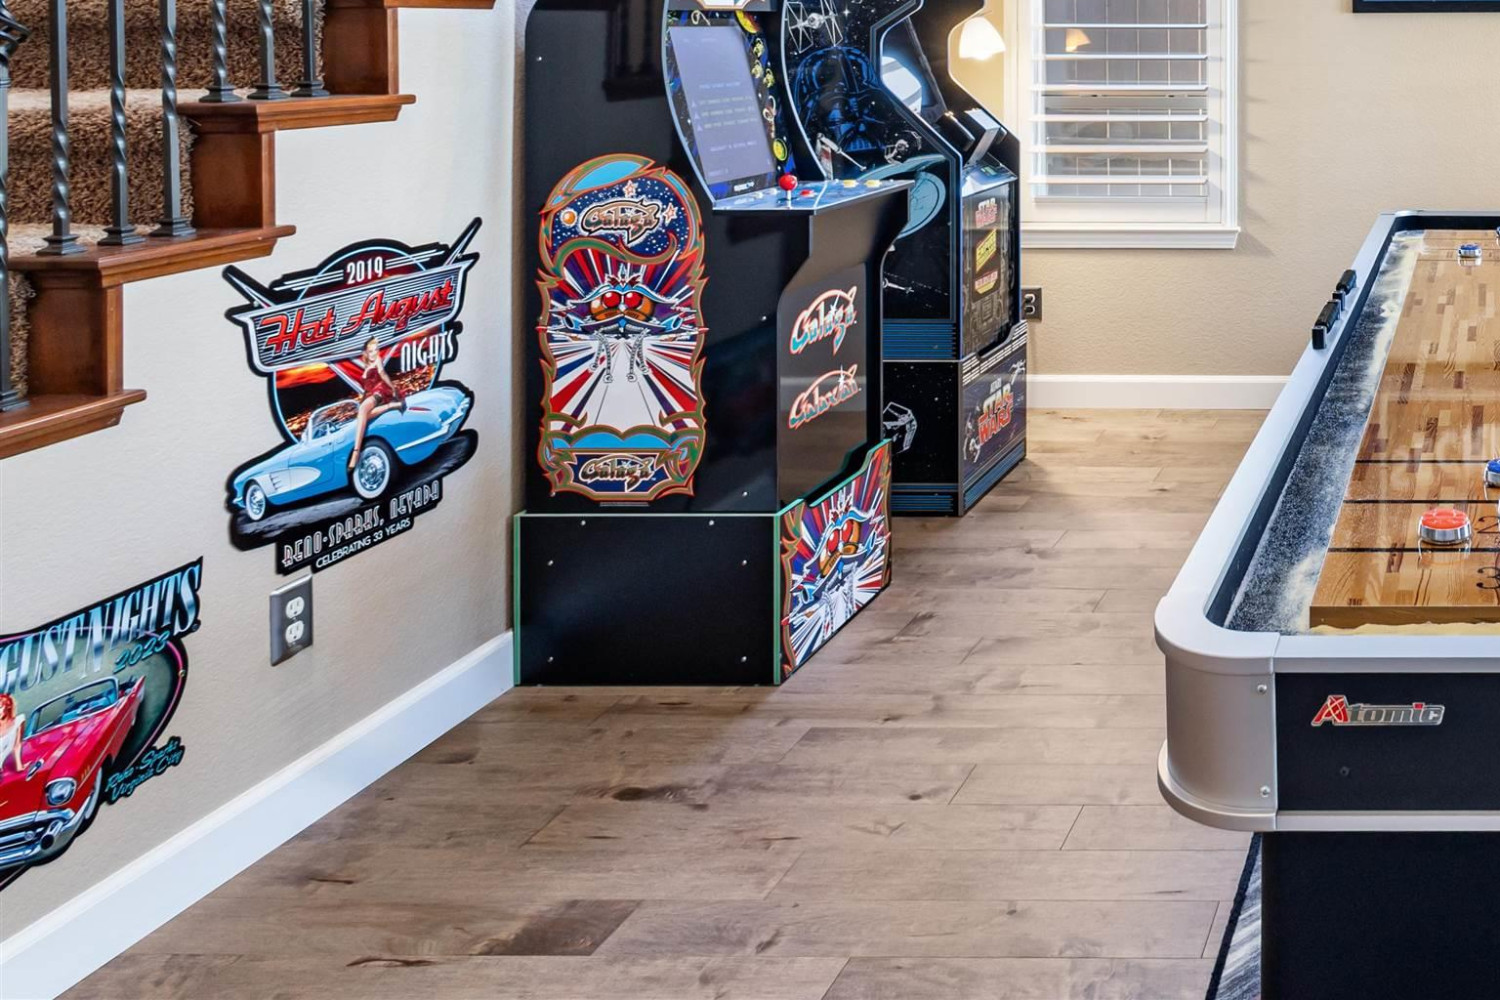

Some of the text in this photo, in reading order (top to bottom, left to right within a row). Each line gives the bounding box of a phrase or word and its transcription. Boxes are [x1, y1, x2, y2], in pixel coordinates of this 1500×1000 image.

[582, 200, 660, 244] Galaga
[346, 256, 383, 284] 2019
[259, 277, 454, 355] Hot August
[790, 286, 857, 355] Galaga
[401, 329, 454, 373] NIGHTS
[978, 383, 1014, 423] STAR
[978, 404, 1012, 446] WARS
[579, 453, 656, 493] Galaga
[389, 480, 439, 520] NEVADA
[315, 518, 411, 568] CELEBRATING 33 YEARS
[80, 564, 201, 680] NIGHTS
[113, 630, 170, 674] 2023
[1311, 694, 1445, 727] Atomic
[156, 749, 183, 773] City
